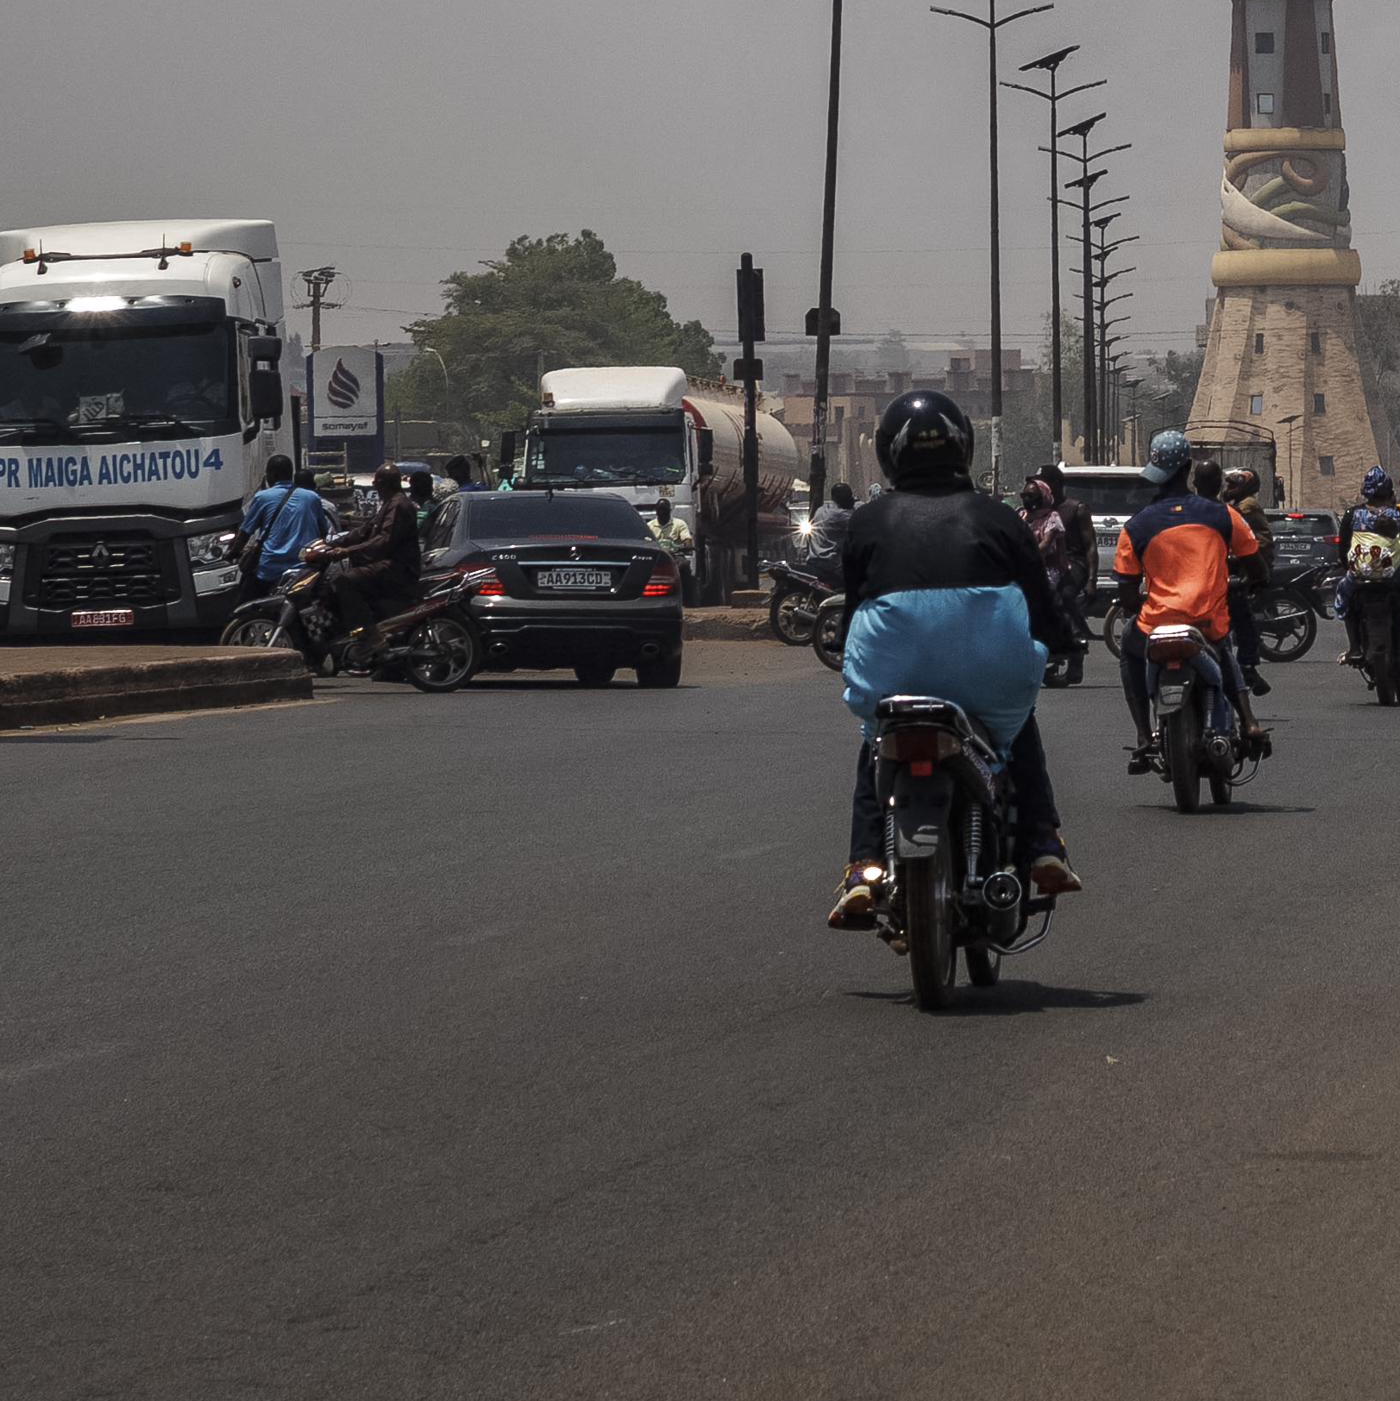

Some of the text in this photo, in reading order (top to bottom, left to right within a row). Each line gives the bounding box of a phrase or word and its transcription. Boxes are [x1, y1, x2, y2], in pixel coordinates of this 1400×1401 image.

[27, 456, 93, 488] MAIGA
[98, 448, 200, 485] AICHATOU
[203, 448, 224, 471] 4
[546, 572, 603, 585] AA913CD
